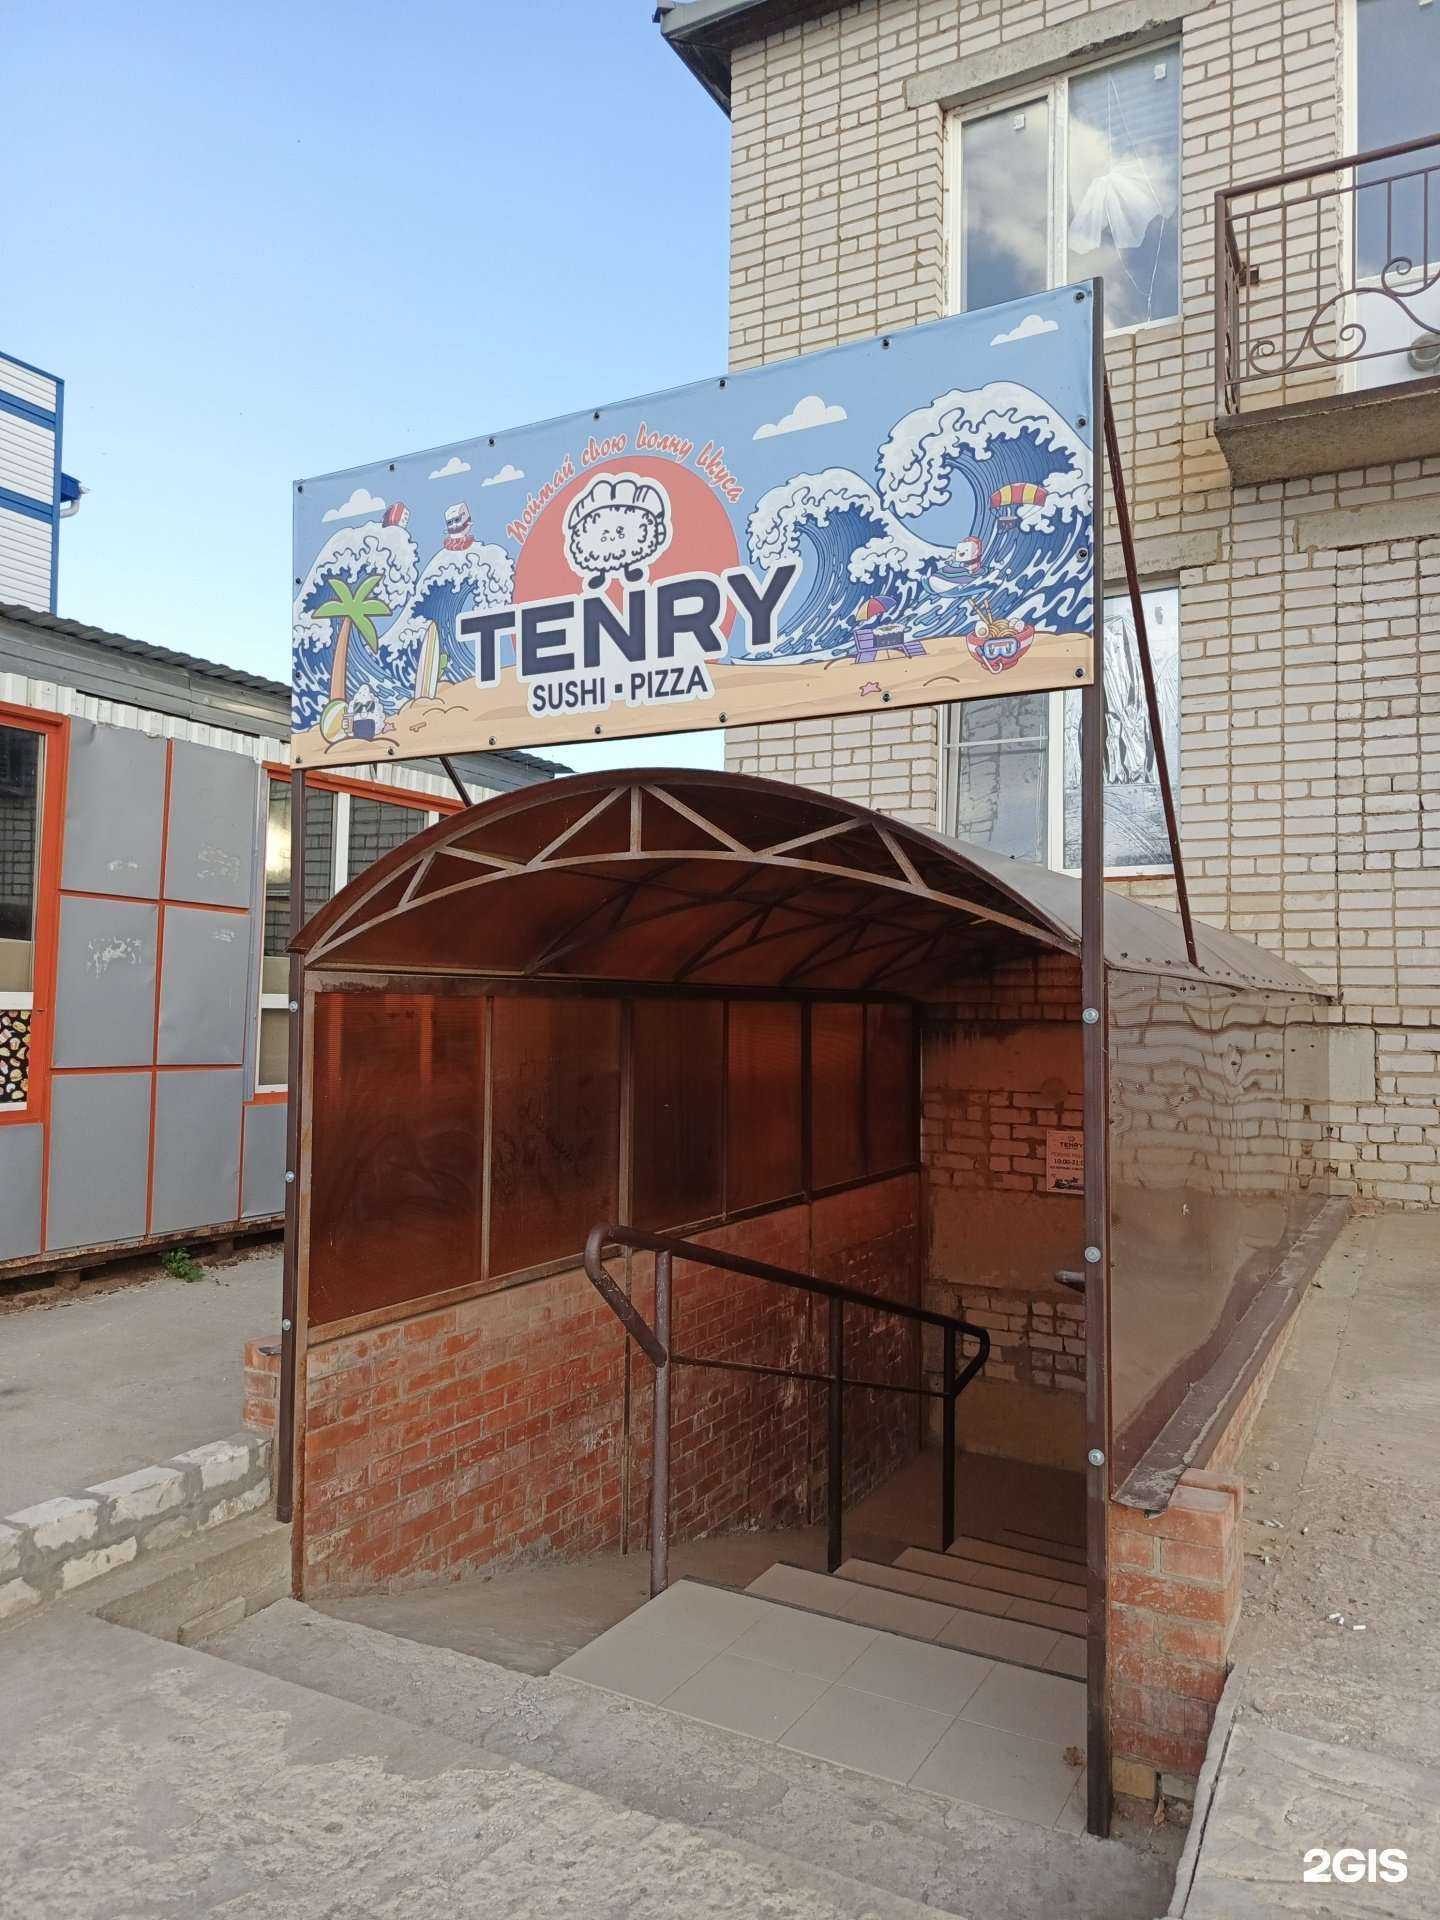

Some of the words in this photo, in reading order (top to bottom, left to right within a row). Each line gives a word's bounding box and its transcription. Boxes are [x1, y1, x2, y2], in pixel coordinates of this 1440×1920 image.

[508, 456, 574, 542] Поймай
[582, 434, 627, 465] свою
[637, 423, 693, 461] волну
[697, 442, 742, 502] вкуса
[461, 565, 796, 681] TENRY
[533, 677, 605, 711] SUSHI
[631, 665, 707, 700] PIZZA
